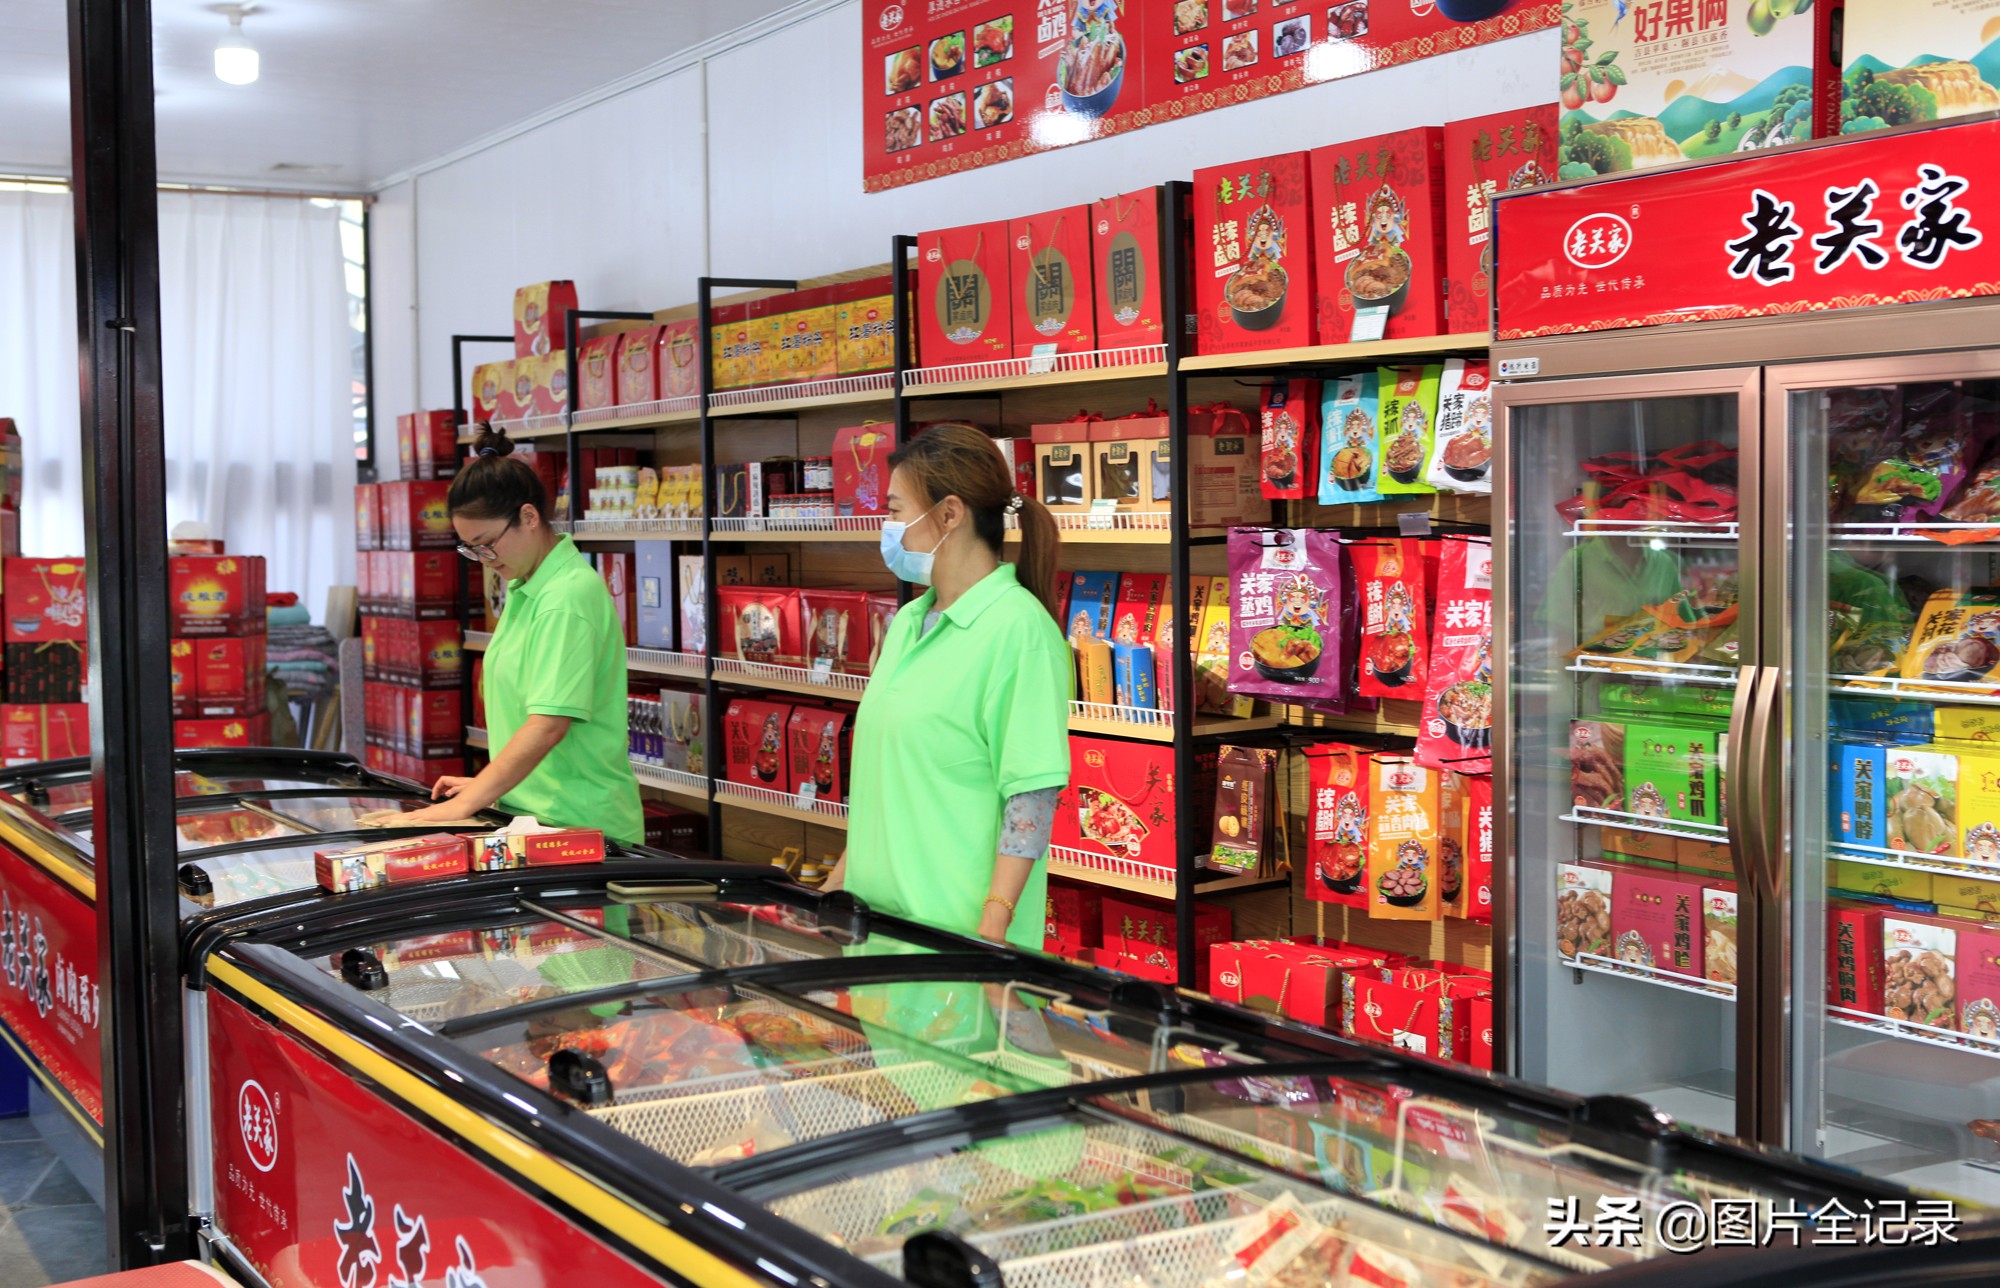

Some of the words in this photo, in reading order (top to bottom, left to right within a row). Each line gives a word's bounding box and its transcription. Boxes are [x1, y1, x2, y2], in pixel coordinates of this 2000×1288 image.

[1634, 0, 1727, 43] 好果俩
[1570, 224, 1625, 258] 老关家
[1725, 162, 1984, 287] 老关家
[1540, 281, 1588, 299] 品质为先
[1595, 275, 1645, 292] 世代传承
[1239, 571, 1275, 596] 关家
[1239, 595, 1275, 618] 蒸鸡
[1384, 793, 1419, 815] 关家
[1854, 757, 1873, 840] 关家鸭脖
[0, 889, 54, 1019] 老关家
[243, 1094, 274, 1157] 老关家
